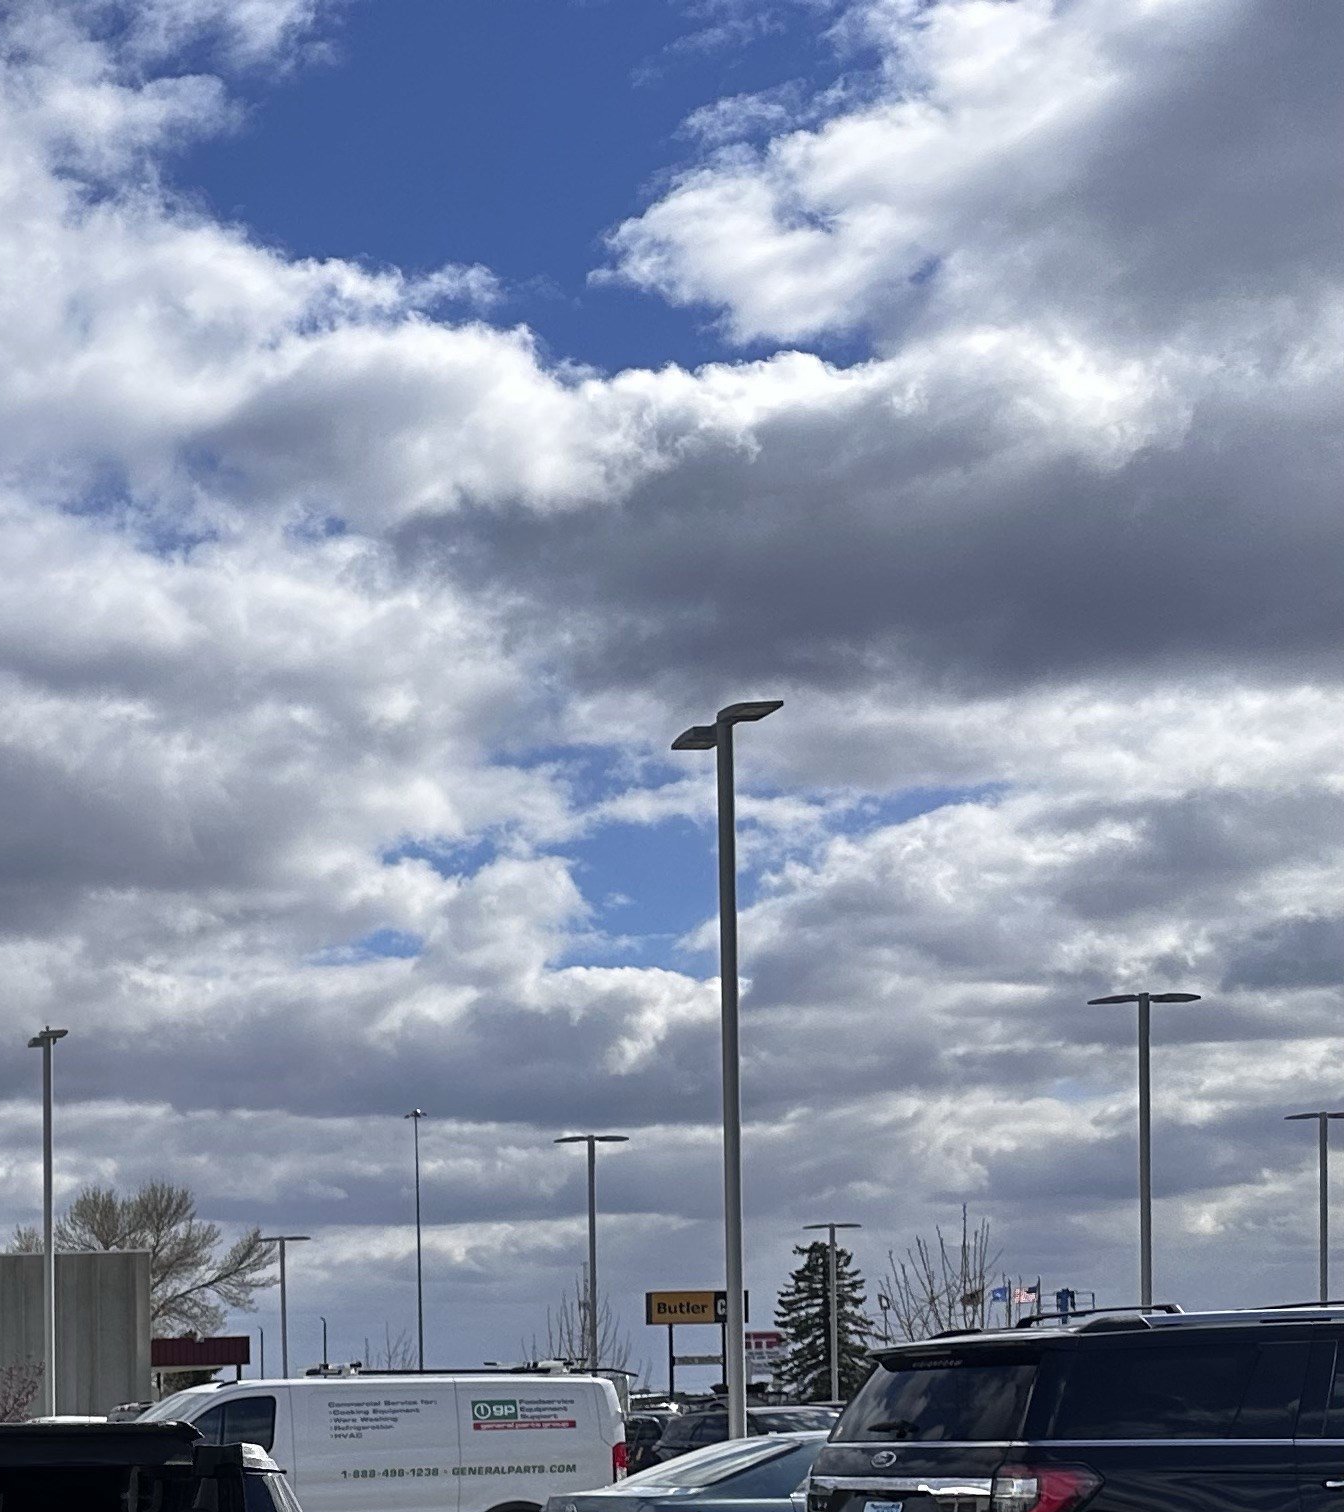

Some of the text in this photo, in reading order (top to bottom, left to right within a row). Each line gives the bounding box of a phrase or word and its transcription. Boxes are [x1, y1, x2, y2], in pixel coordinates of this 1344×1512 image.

[656, 1301, 709, 1315] Butler
[492, 1404, 516, 1417] gp
[451, 1464, 577, 1476] GENERALPARTS.COM
